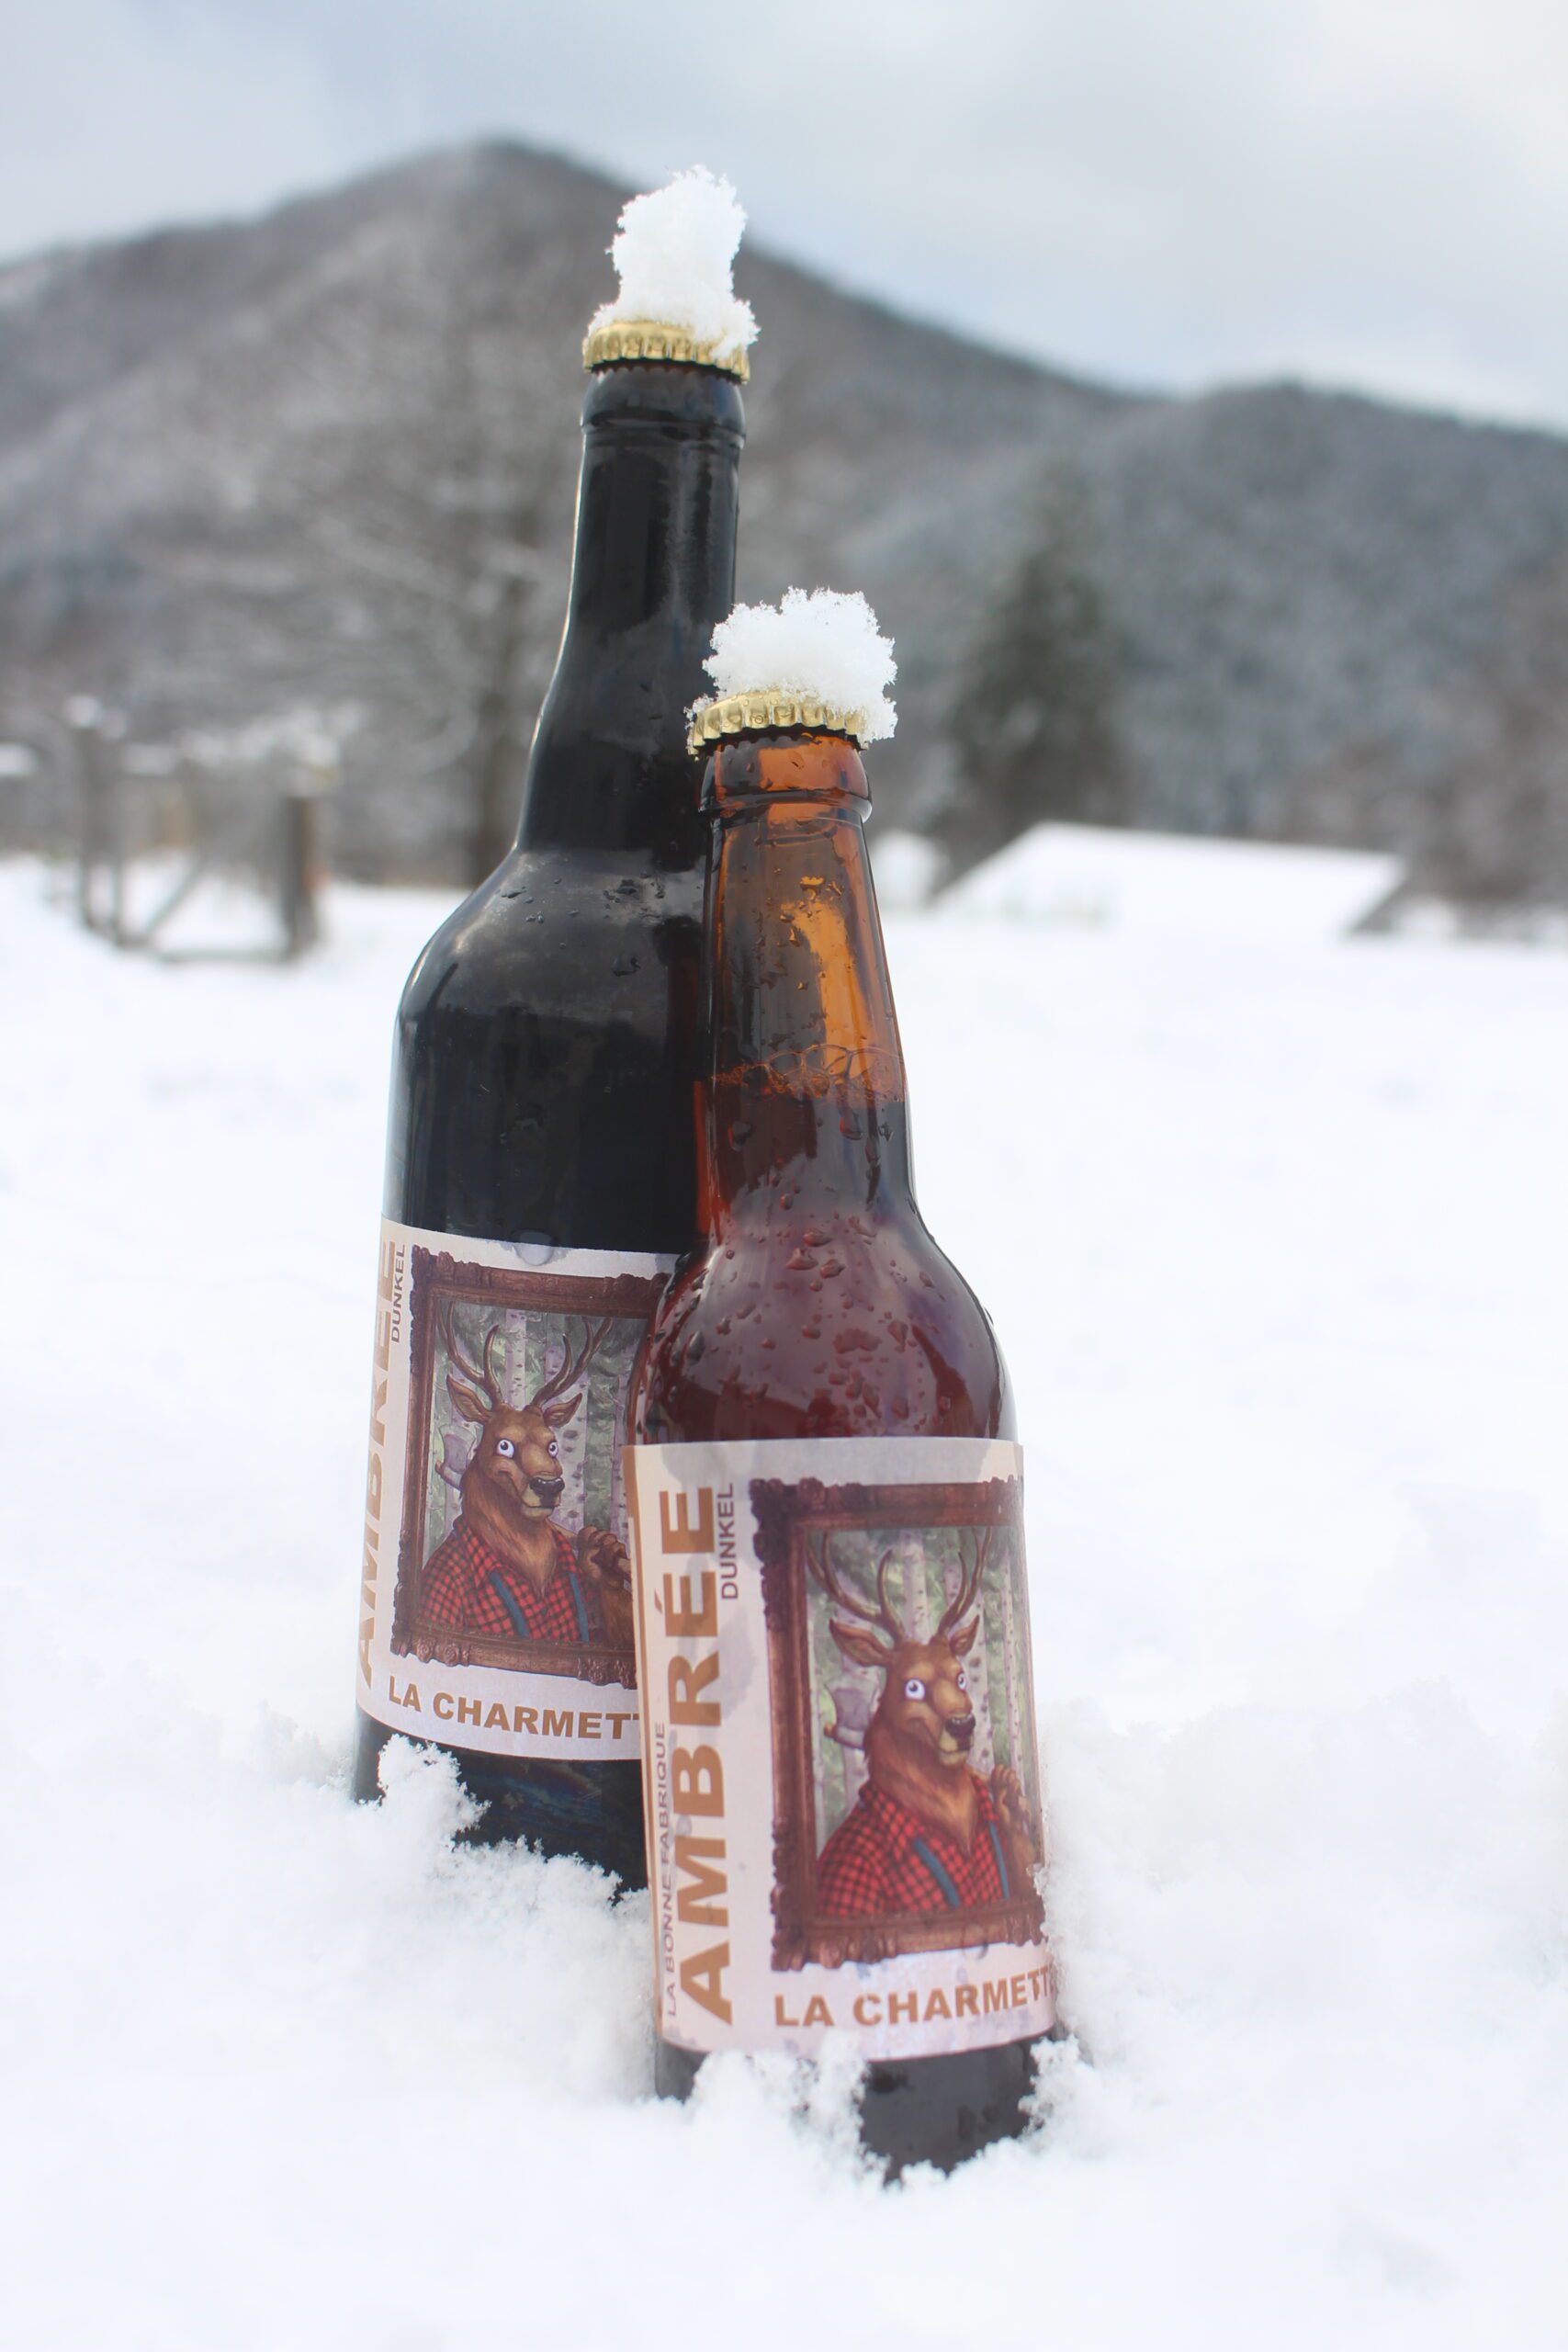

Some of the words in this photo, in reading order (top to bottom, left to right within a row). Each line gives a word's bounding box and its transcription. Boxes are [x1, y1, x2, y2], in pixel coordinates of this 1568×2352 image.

[391, 1243, 405, 1343] DUNKEL
[717, 1482, 739, 1600] DUNKEL
[389, 1675, 422, 1713] LA
[433, 1691, 639, 1740] CHARMET
[654, 1487, 733, 2026] AMBRÉE
[655, 1721, 671, 1865] FABRIQUE
[661, 1872, 675, 1973] BONNE
[667, 1982, 677, 2017] LA
[774, 1994, 835, 2027] LA
